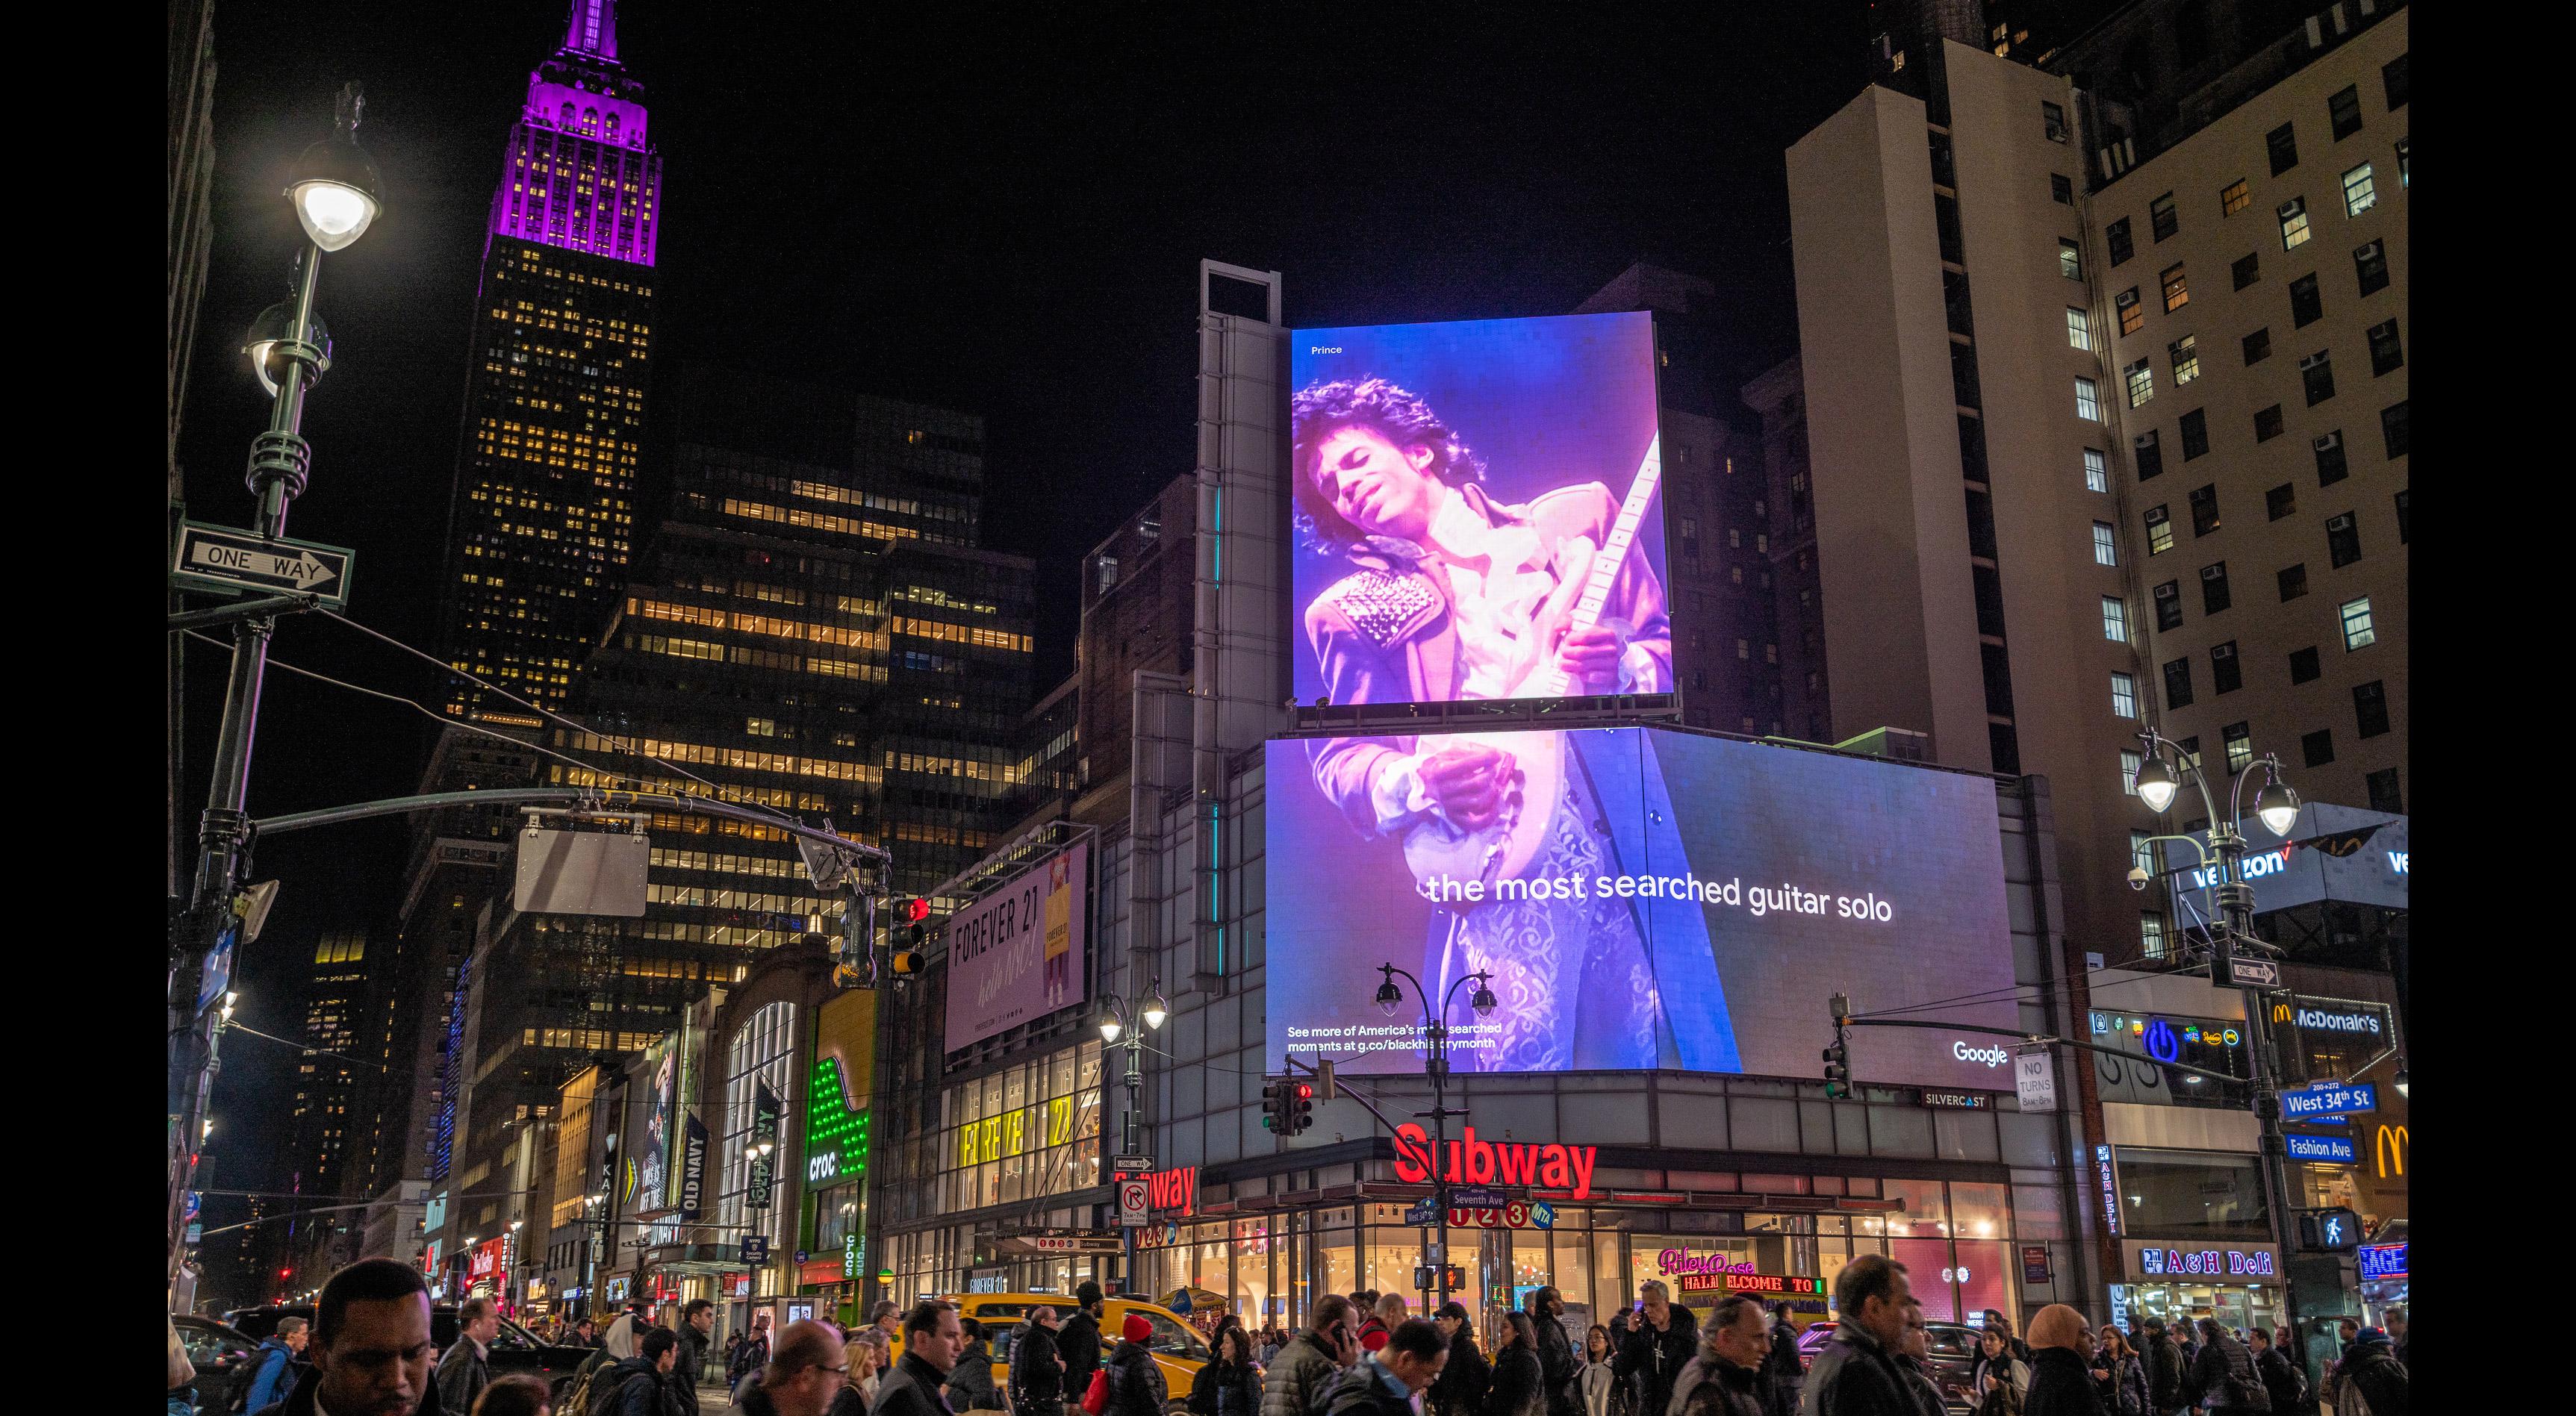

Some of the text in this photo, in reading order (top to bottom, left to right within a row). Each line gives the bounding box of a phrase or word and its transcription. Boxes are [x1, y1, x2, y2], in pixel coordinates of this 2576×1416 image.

[1311, 346, 1343, 355] Prince
[208, 547, 321, 580] ONE WAY
[1426, 871, 1893, 922] the most searched guitar solo
[955, 885, 1038, 967] FOREVER 21
[1046, 926, 1063, 943] FOREVER
[2239, 967, 2271, 979] ONE WAY
[1288, 1026, 1309, 1038] See
[1311, 1027, 1342, 1037] more
[1343, 1025, 1357, 1037] of
[1357, 1024, 1415, 1036] America's
[1449, 1023, 1502, 1035] searched
[2298, 1009, 2380, 1033] McDonald's
[1288, 1041, 1342, 1052] moments
[1344, 1041, 1356, 1051] at
[1953, 1041, 2008, 1068] Google
[2024, 1061, 2042, 1076] NO
[2020, 1079, 2051, 1093] TURNS
[1926, 1094, 1985, 1107] SILVERCAST
[2022, 1097, 2052, 1106] 8AM-8PM
[2288, 1090, 2369, 1112] West 34th St
[1054, 1096, 1071, 1147] 21
[2291, 1139, 2351, 1157] Fashion Ave
[1394, 1123, 1597, 1200] Subway
[602, 1164, 612, 1204] KAY
[684, 1137, 703, 1211] OLD NAVY
[1455, 1194, 1504, 1206] Seventh Ave
[2101, 1162, 2116, 1233] A&H DELI
[1407, 1212, 1419, 1222] West
[1428, 1211, 1434, 1220] St
[1481, 1208, 1493, 1223] 2
[1510, 1205, 1523, 1224] 3
[1531, 1203, 1550, 1225] MTA
[659, 1214, 682, 1245] NAVY
[1136, 1229, 1139, 1245] 1
[1146, 1227, 1152, 1244] 2
[1157, 1226, 1163, 1243] 3
[845, 1235, 855, 1276] crocs
[1659, 1246, 1708, 1276] Riley
[2167, 1250, 2273, 1274] A&H Deli
[971, 1276, 1003, 1294] FOREVER 21
[1792, 1279, 1812, 1293] TO
